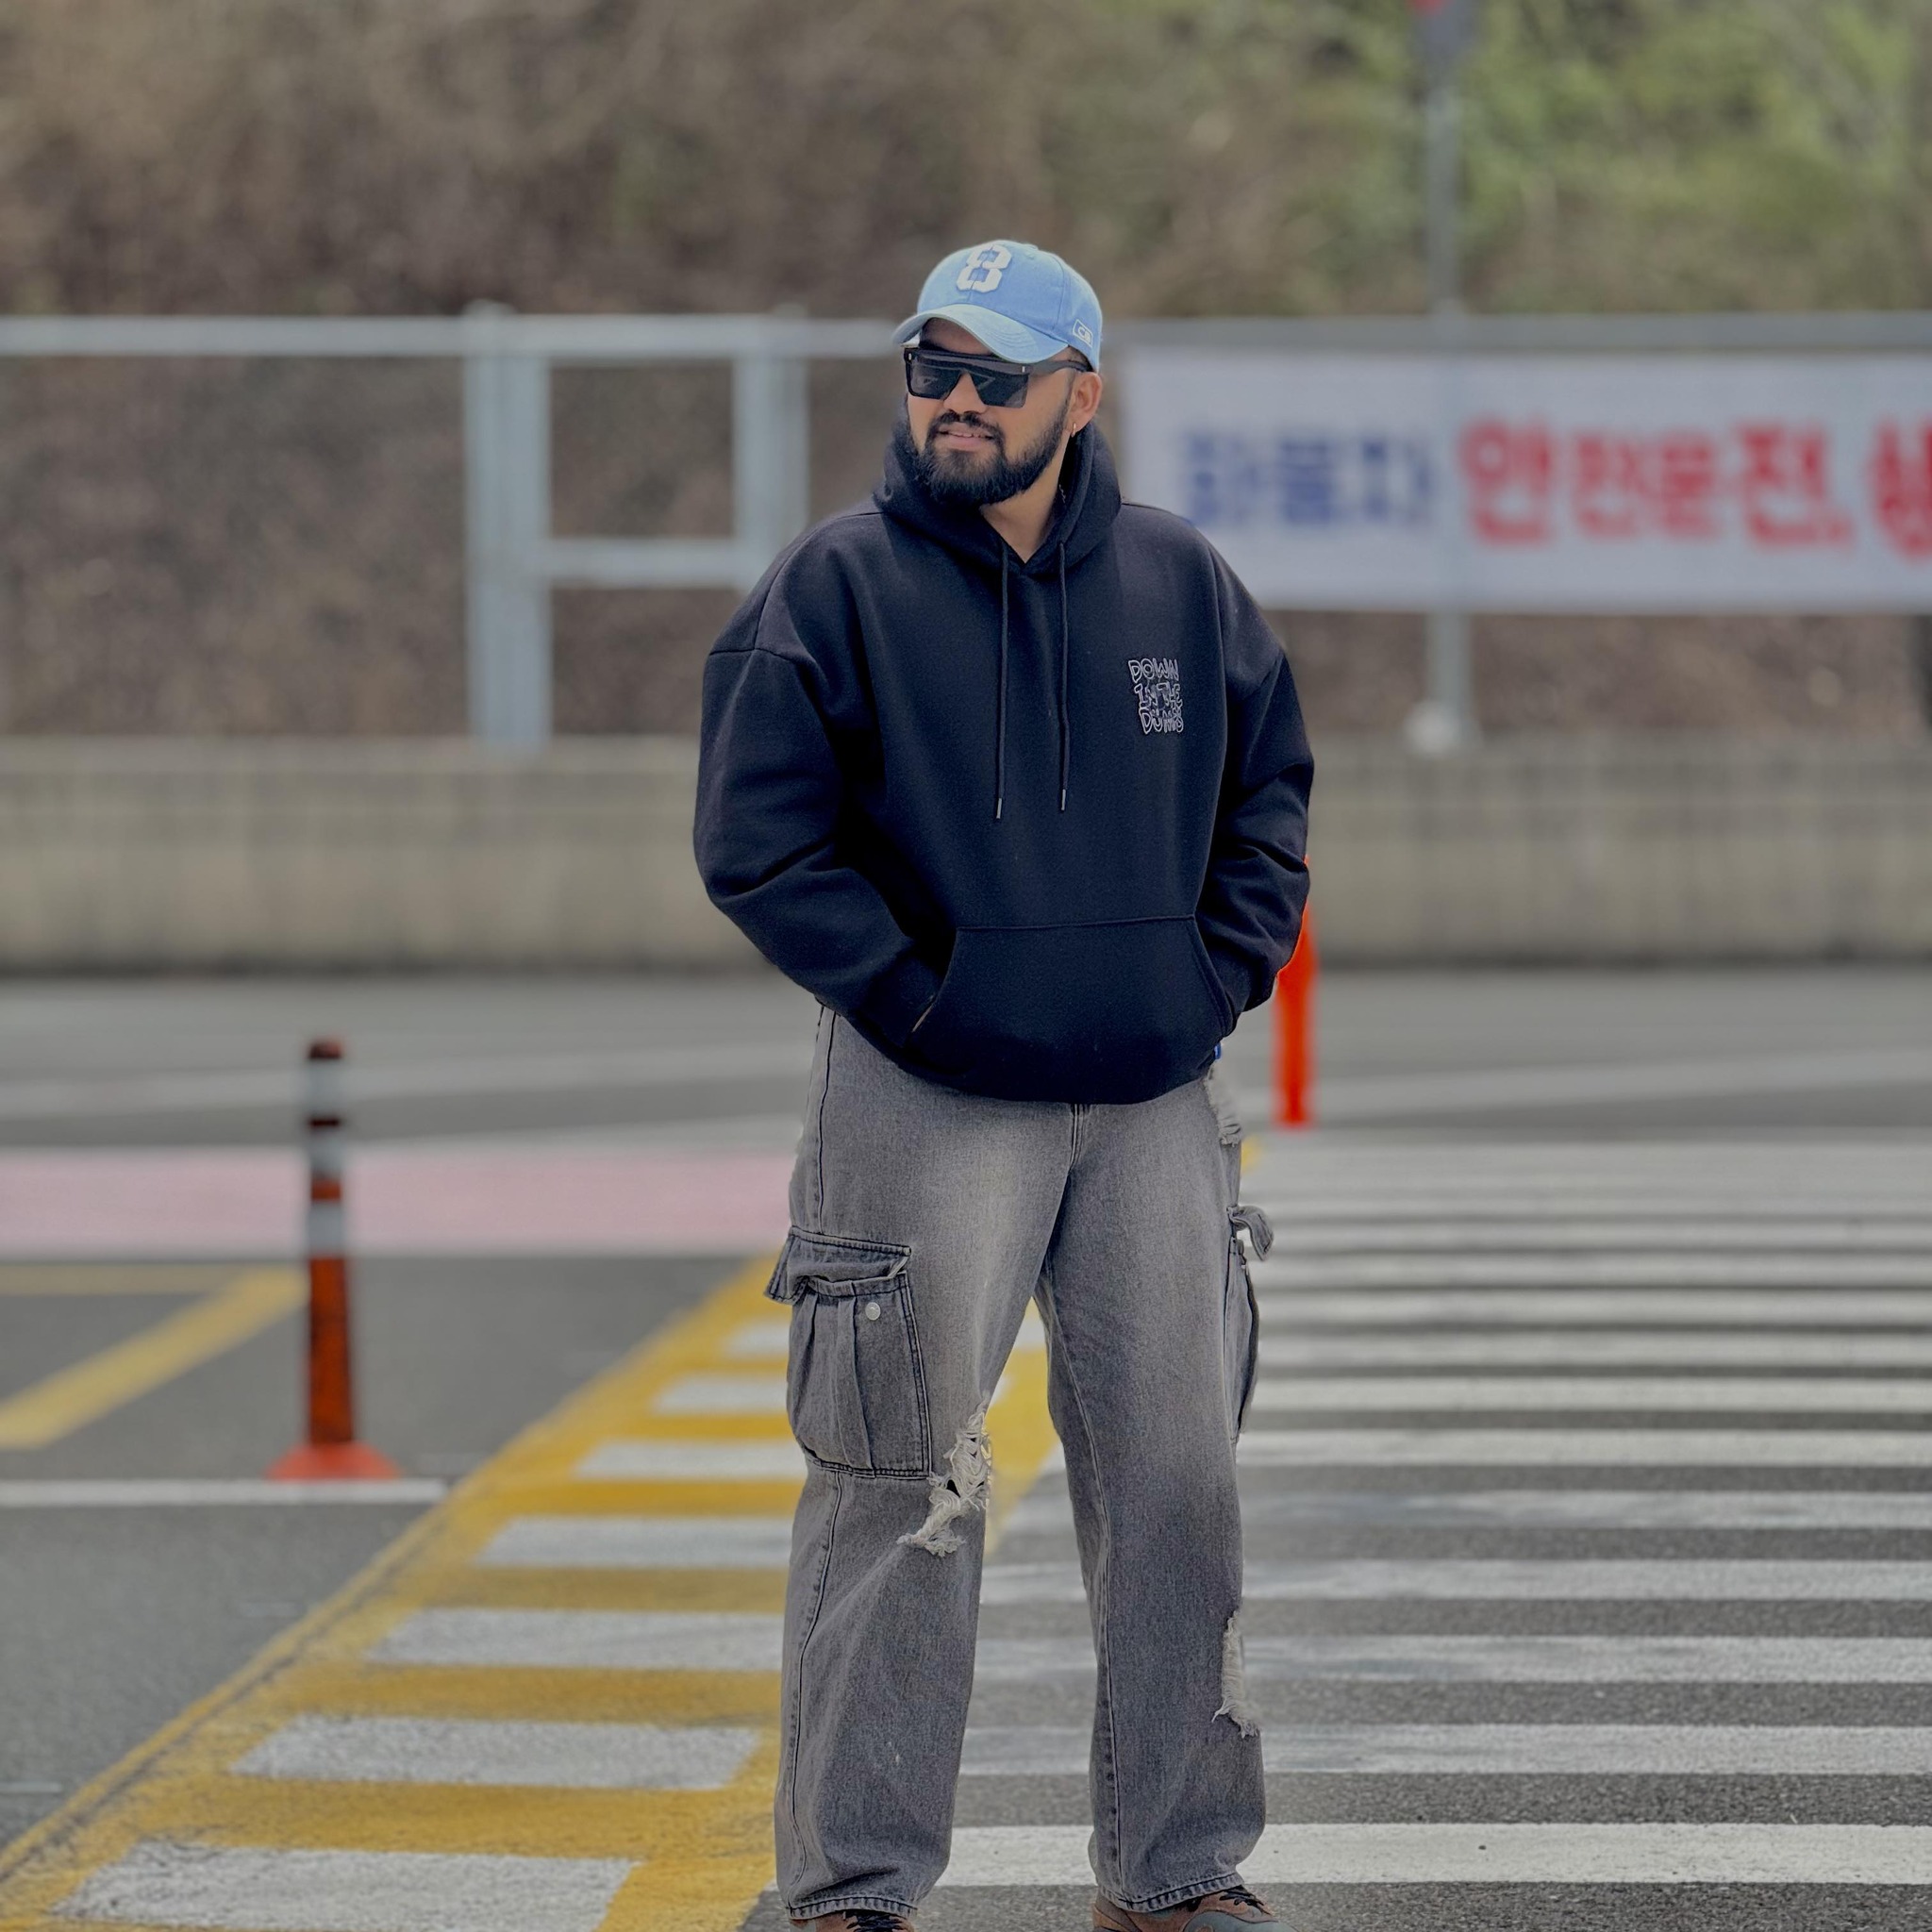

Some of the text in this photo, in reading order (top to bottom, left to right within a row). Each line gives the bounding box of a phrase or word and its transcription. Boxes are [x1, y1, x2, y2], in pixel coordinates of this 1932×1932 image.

[956, 244, 1012, 293] 8
[1127, 658, 1179, 683] DOWN
[1134, 681, 1183, 708] IN THE
